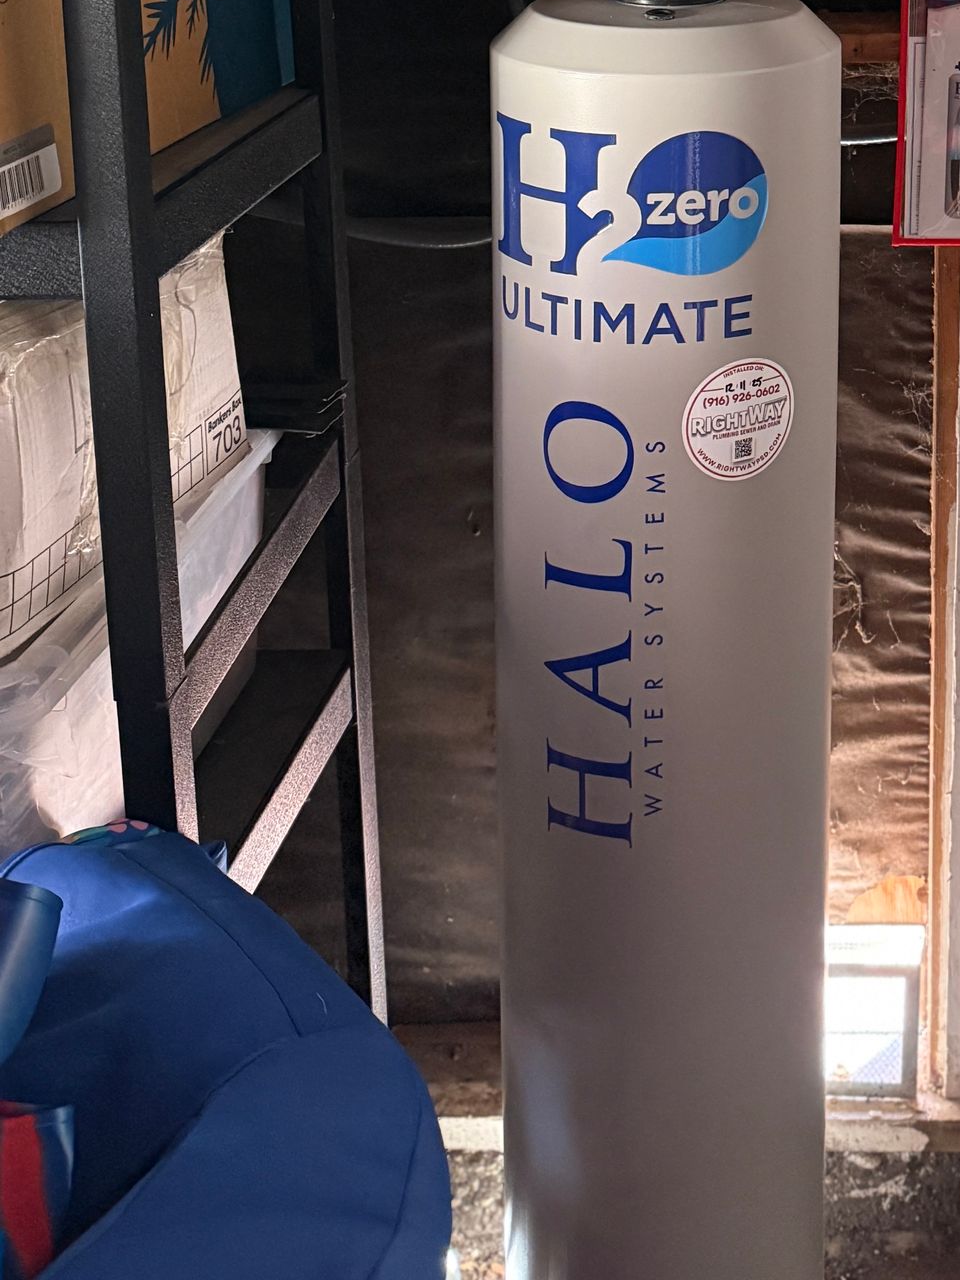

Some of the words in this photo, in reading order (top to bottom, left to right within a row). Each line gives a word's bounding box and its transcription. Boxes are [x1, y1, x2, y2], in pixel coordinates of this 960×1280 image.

[646, 186, 759, 226] zero
[502, 274, 753, 345] ULTIMATE
[723, 366, 754, 378] INSTALLED
[208, 407, 232, 433] Bankers
[232, 396, 242, 412] Box
[691, 395, 788, 437] RIGHTWAY
[703, 395, 730, 409] (916)
[732, 383, 780, 403] 926-0602
[212, 415, 242, 462] 703
[697, 432, 782, 472] WWW.RIGHTWAYPSD.COM
[644, 440, 667, 646] SYSTEMS
[543, 400, 635, 849] HALO
[643, 677, 664, 817] WATER
